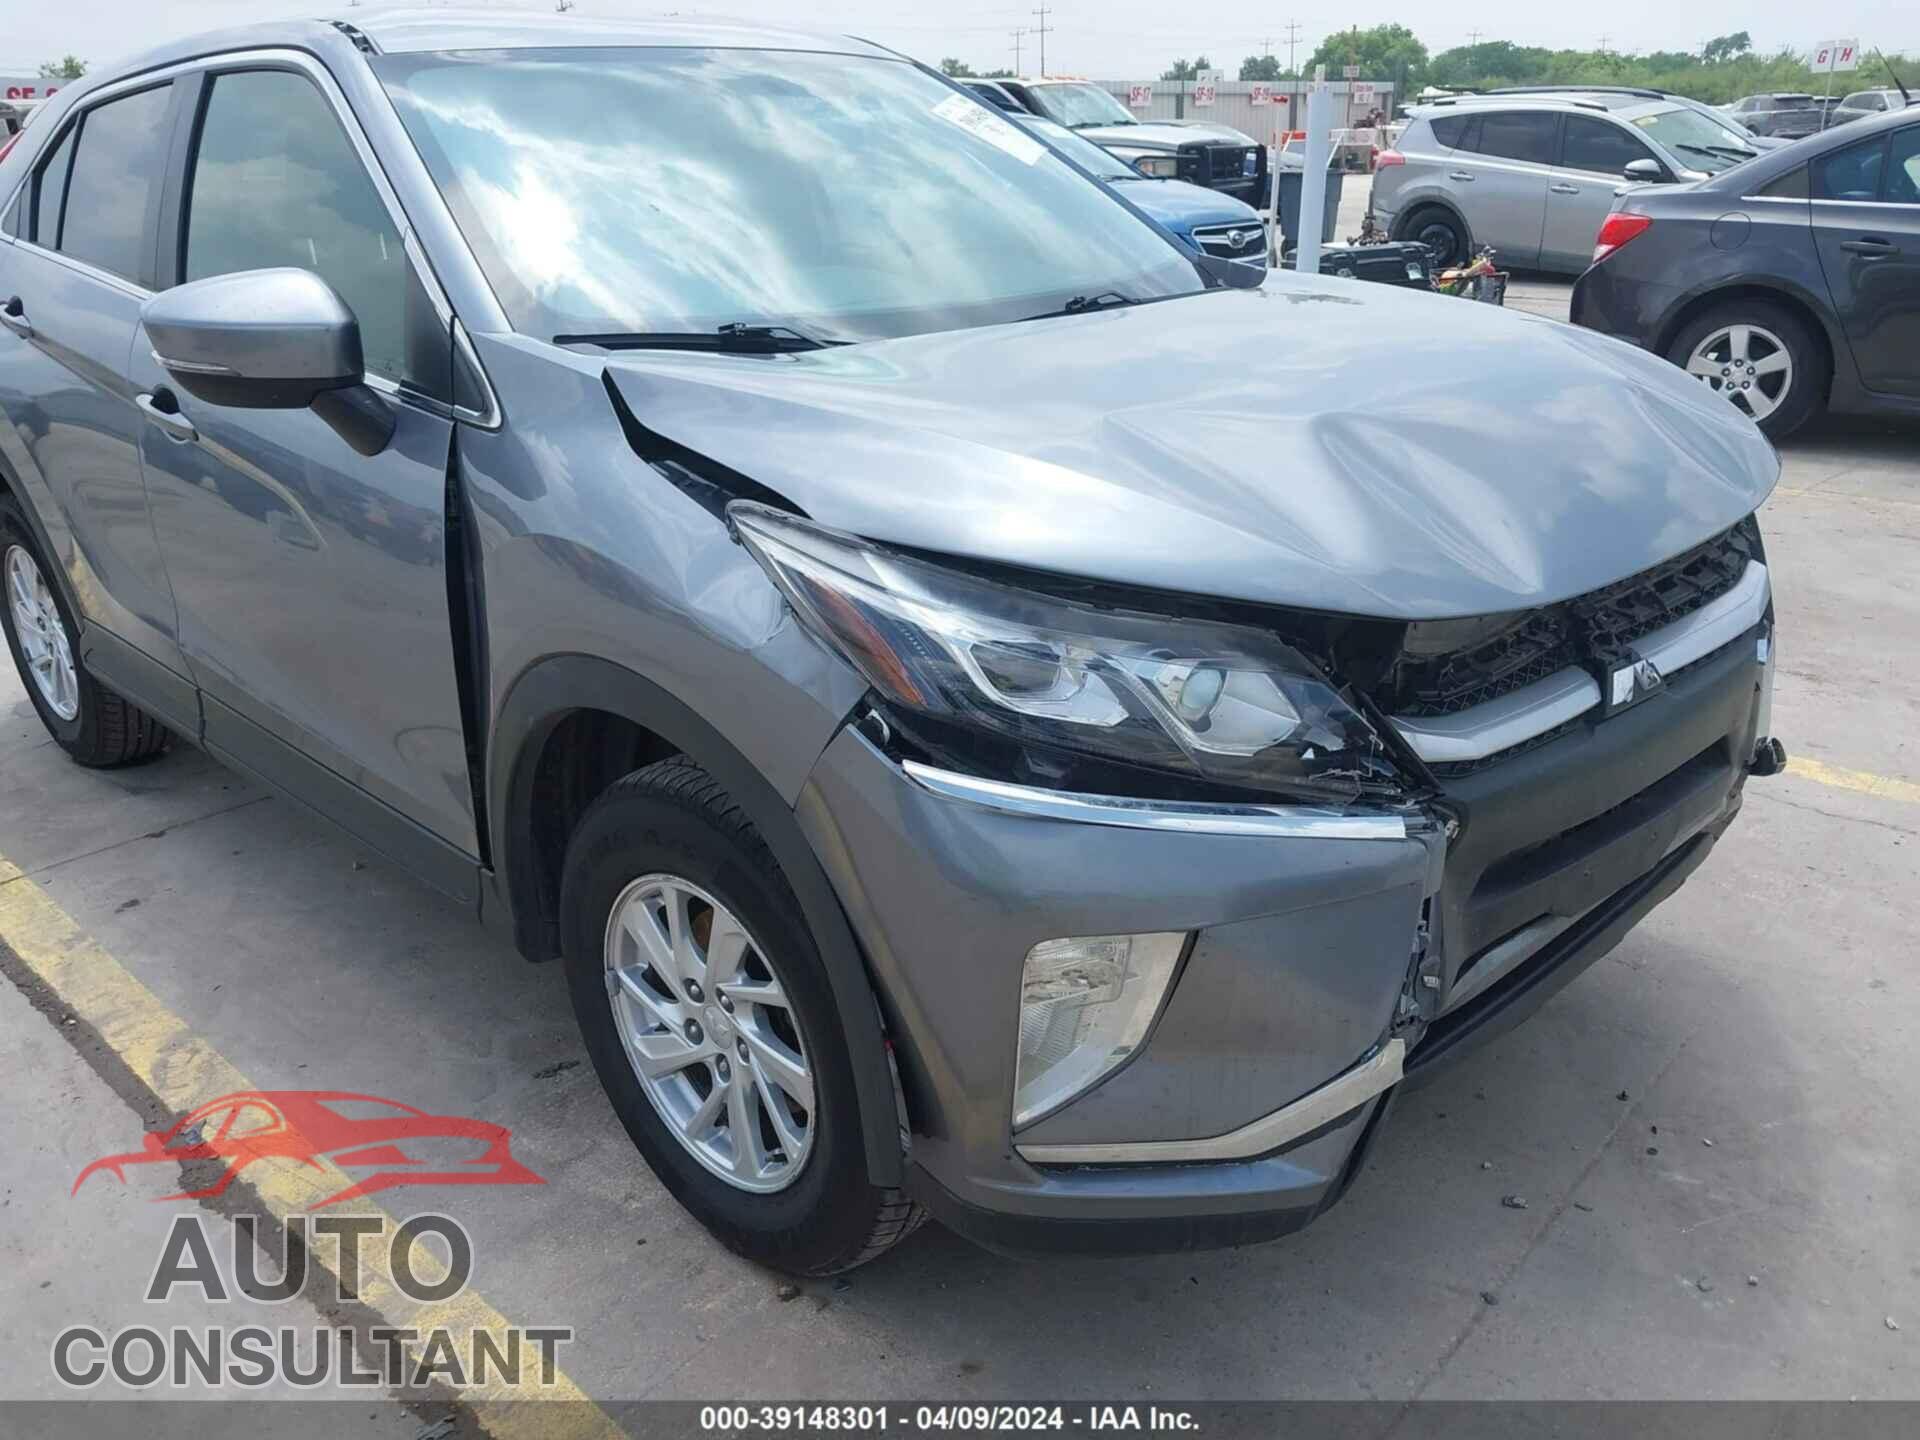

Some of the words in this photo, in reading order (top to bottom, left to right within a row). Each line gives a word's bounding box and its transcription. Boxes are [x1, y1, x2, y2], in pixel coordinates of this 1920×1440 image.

[1816, 49, 1829, 64] G
[1839, 47, 1853, 62] H
[1131, 86, 1152, 102] SF-17
